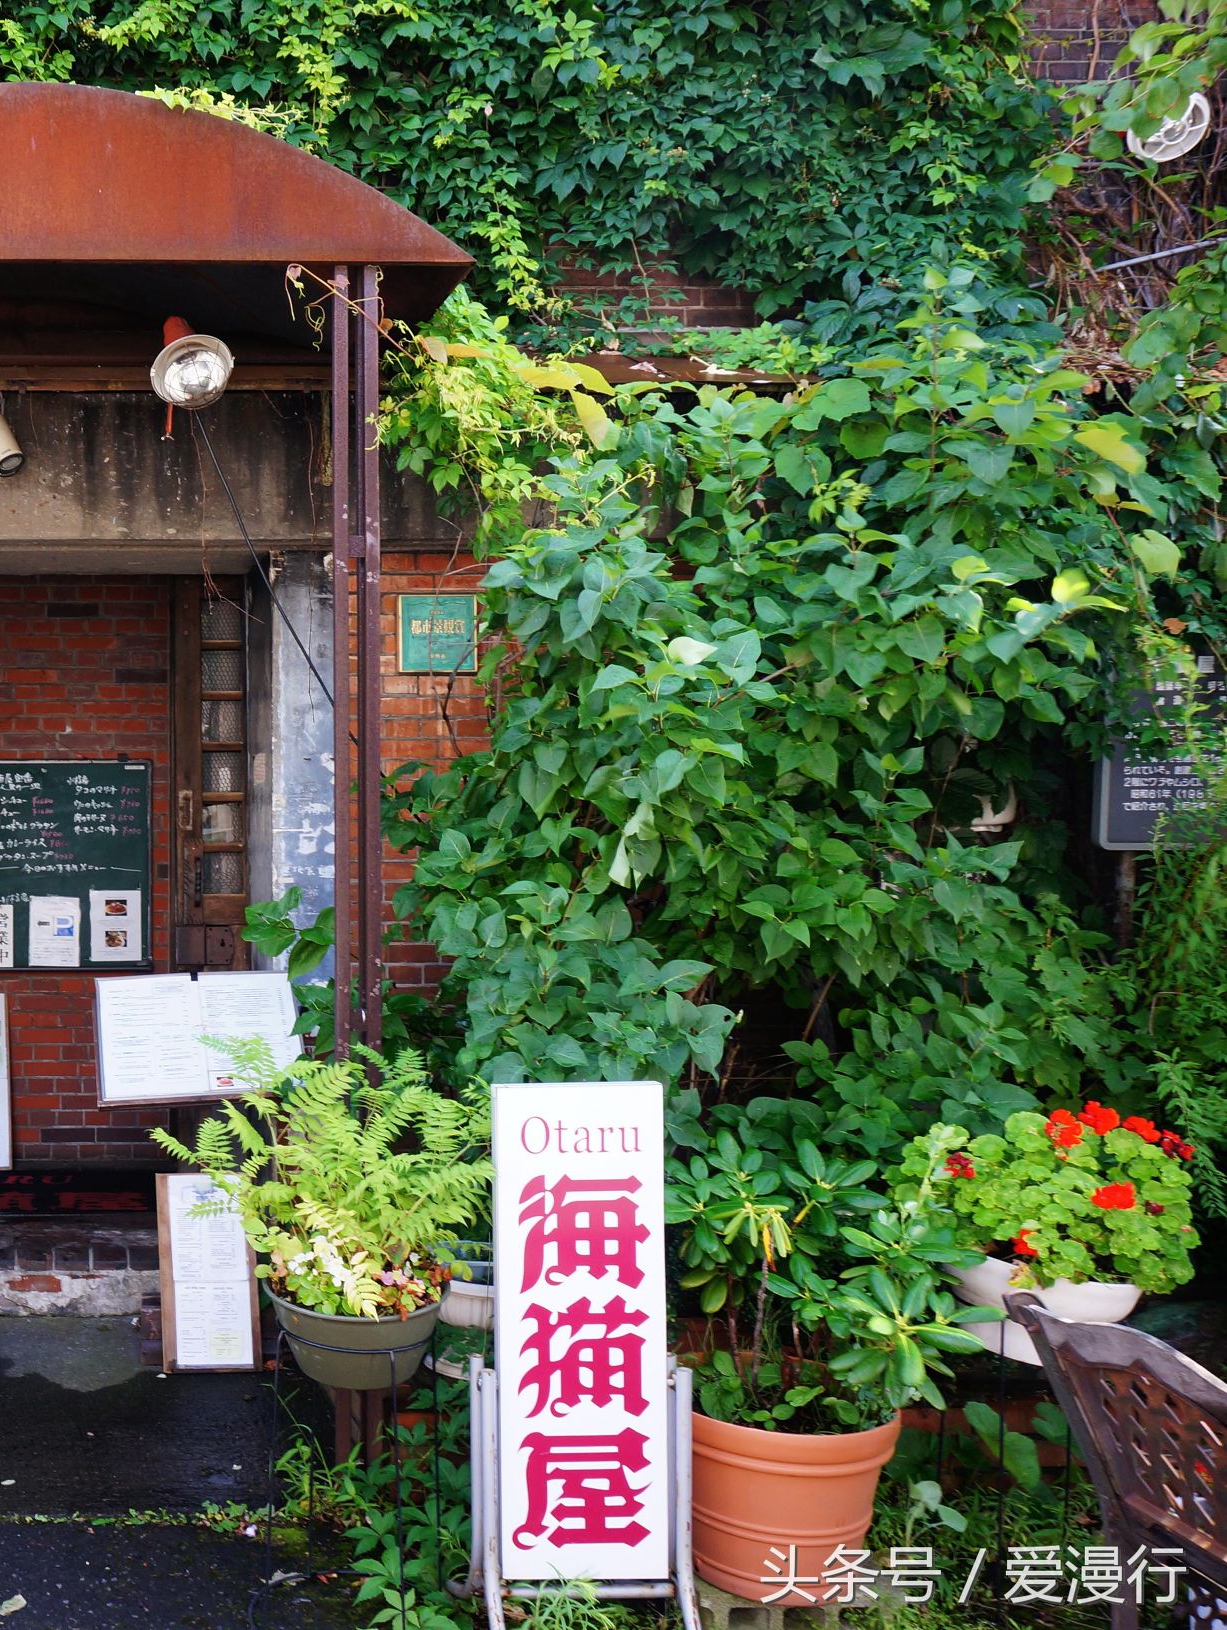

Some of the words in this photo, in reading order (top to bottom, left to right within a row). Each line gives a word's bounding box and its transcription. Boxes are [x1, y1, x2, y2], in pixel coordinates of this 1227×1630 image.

[520, 1115, 643, 1156] Otaru
[512, 1174, 653, 1551] 海猫屋
